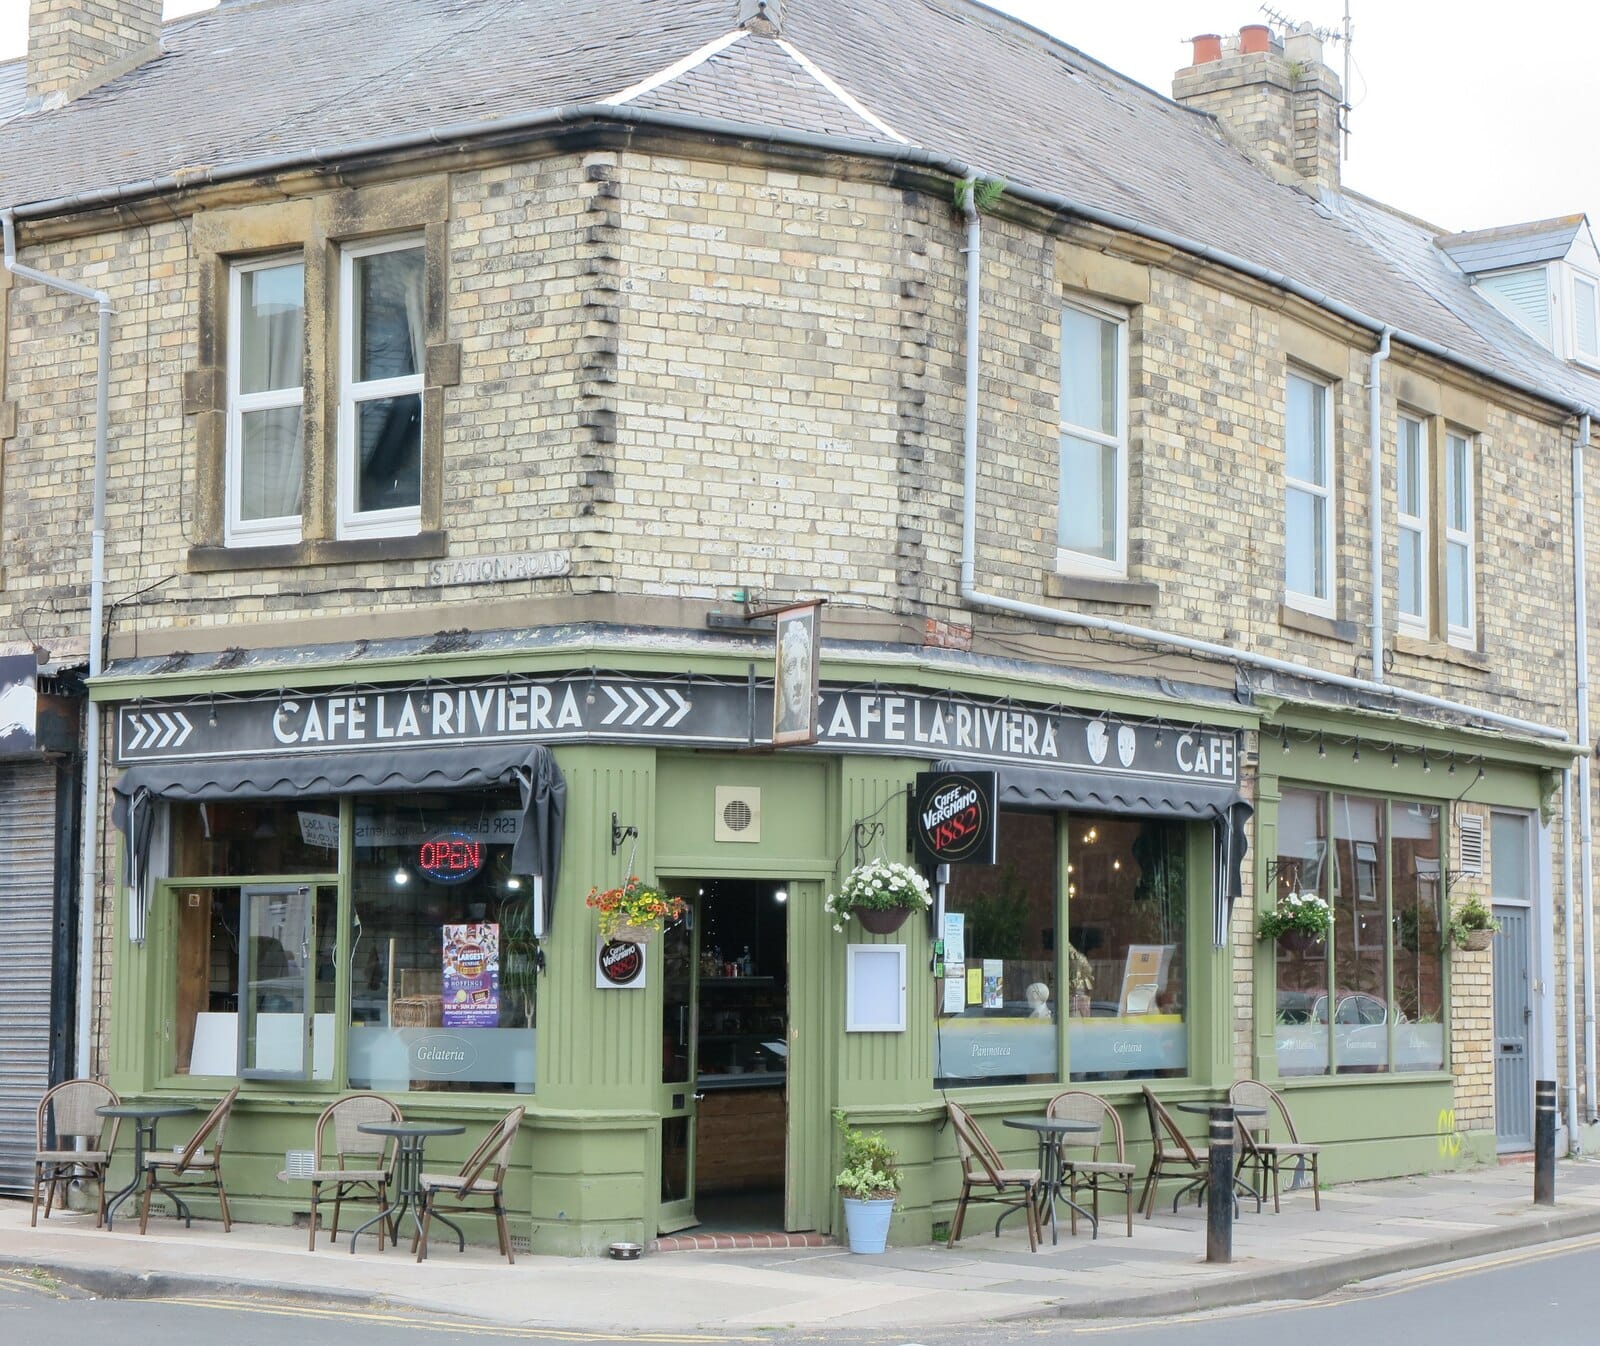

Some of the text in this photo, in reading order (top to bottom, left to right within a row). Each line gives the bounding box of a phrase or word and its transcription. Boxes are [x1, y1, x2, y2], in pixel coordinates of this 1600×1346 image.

[432, 552, 566, 583] STATION ROAD
[273, 683, 583, 744] CAFE LA RIVIERA
[914, 699, 949, 746] LA
[956, 704, 1059, 758] RIVIERA
[1176, 734, 1233, 776] CAFE
[922, 789, 977, 831] VERGNANO
[934, 806, 977, 850] 1882
[420, 840, 480, 870] OPEN
[417, 1046, 465, 1061] Gelateria
